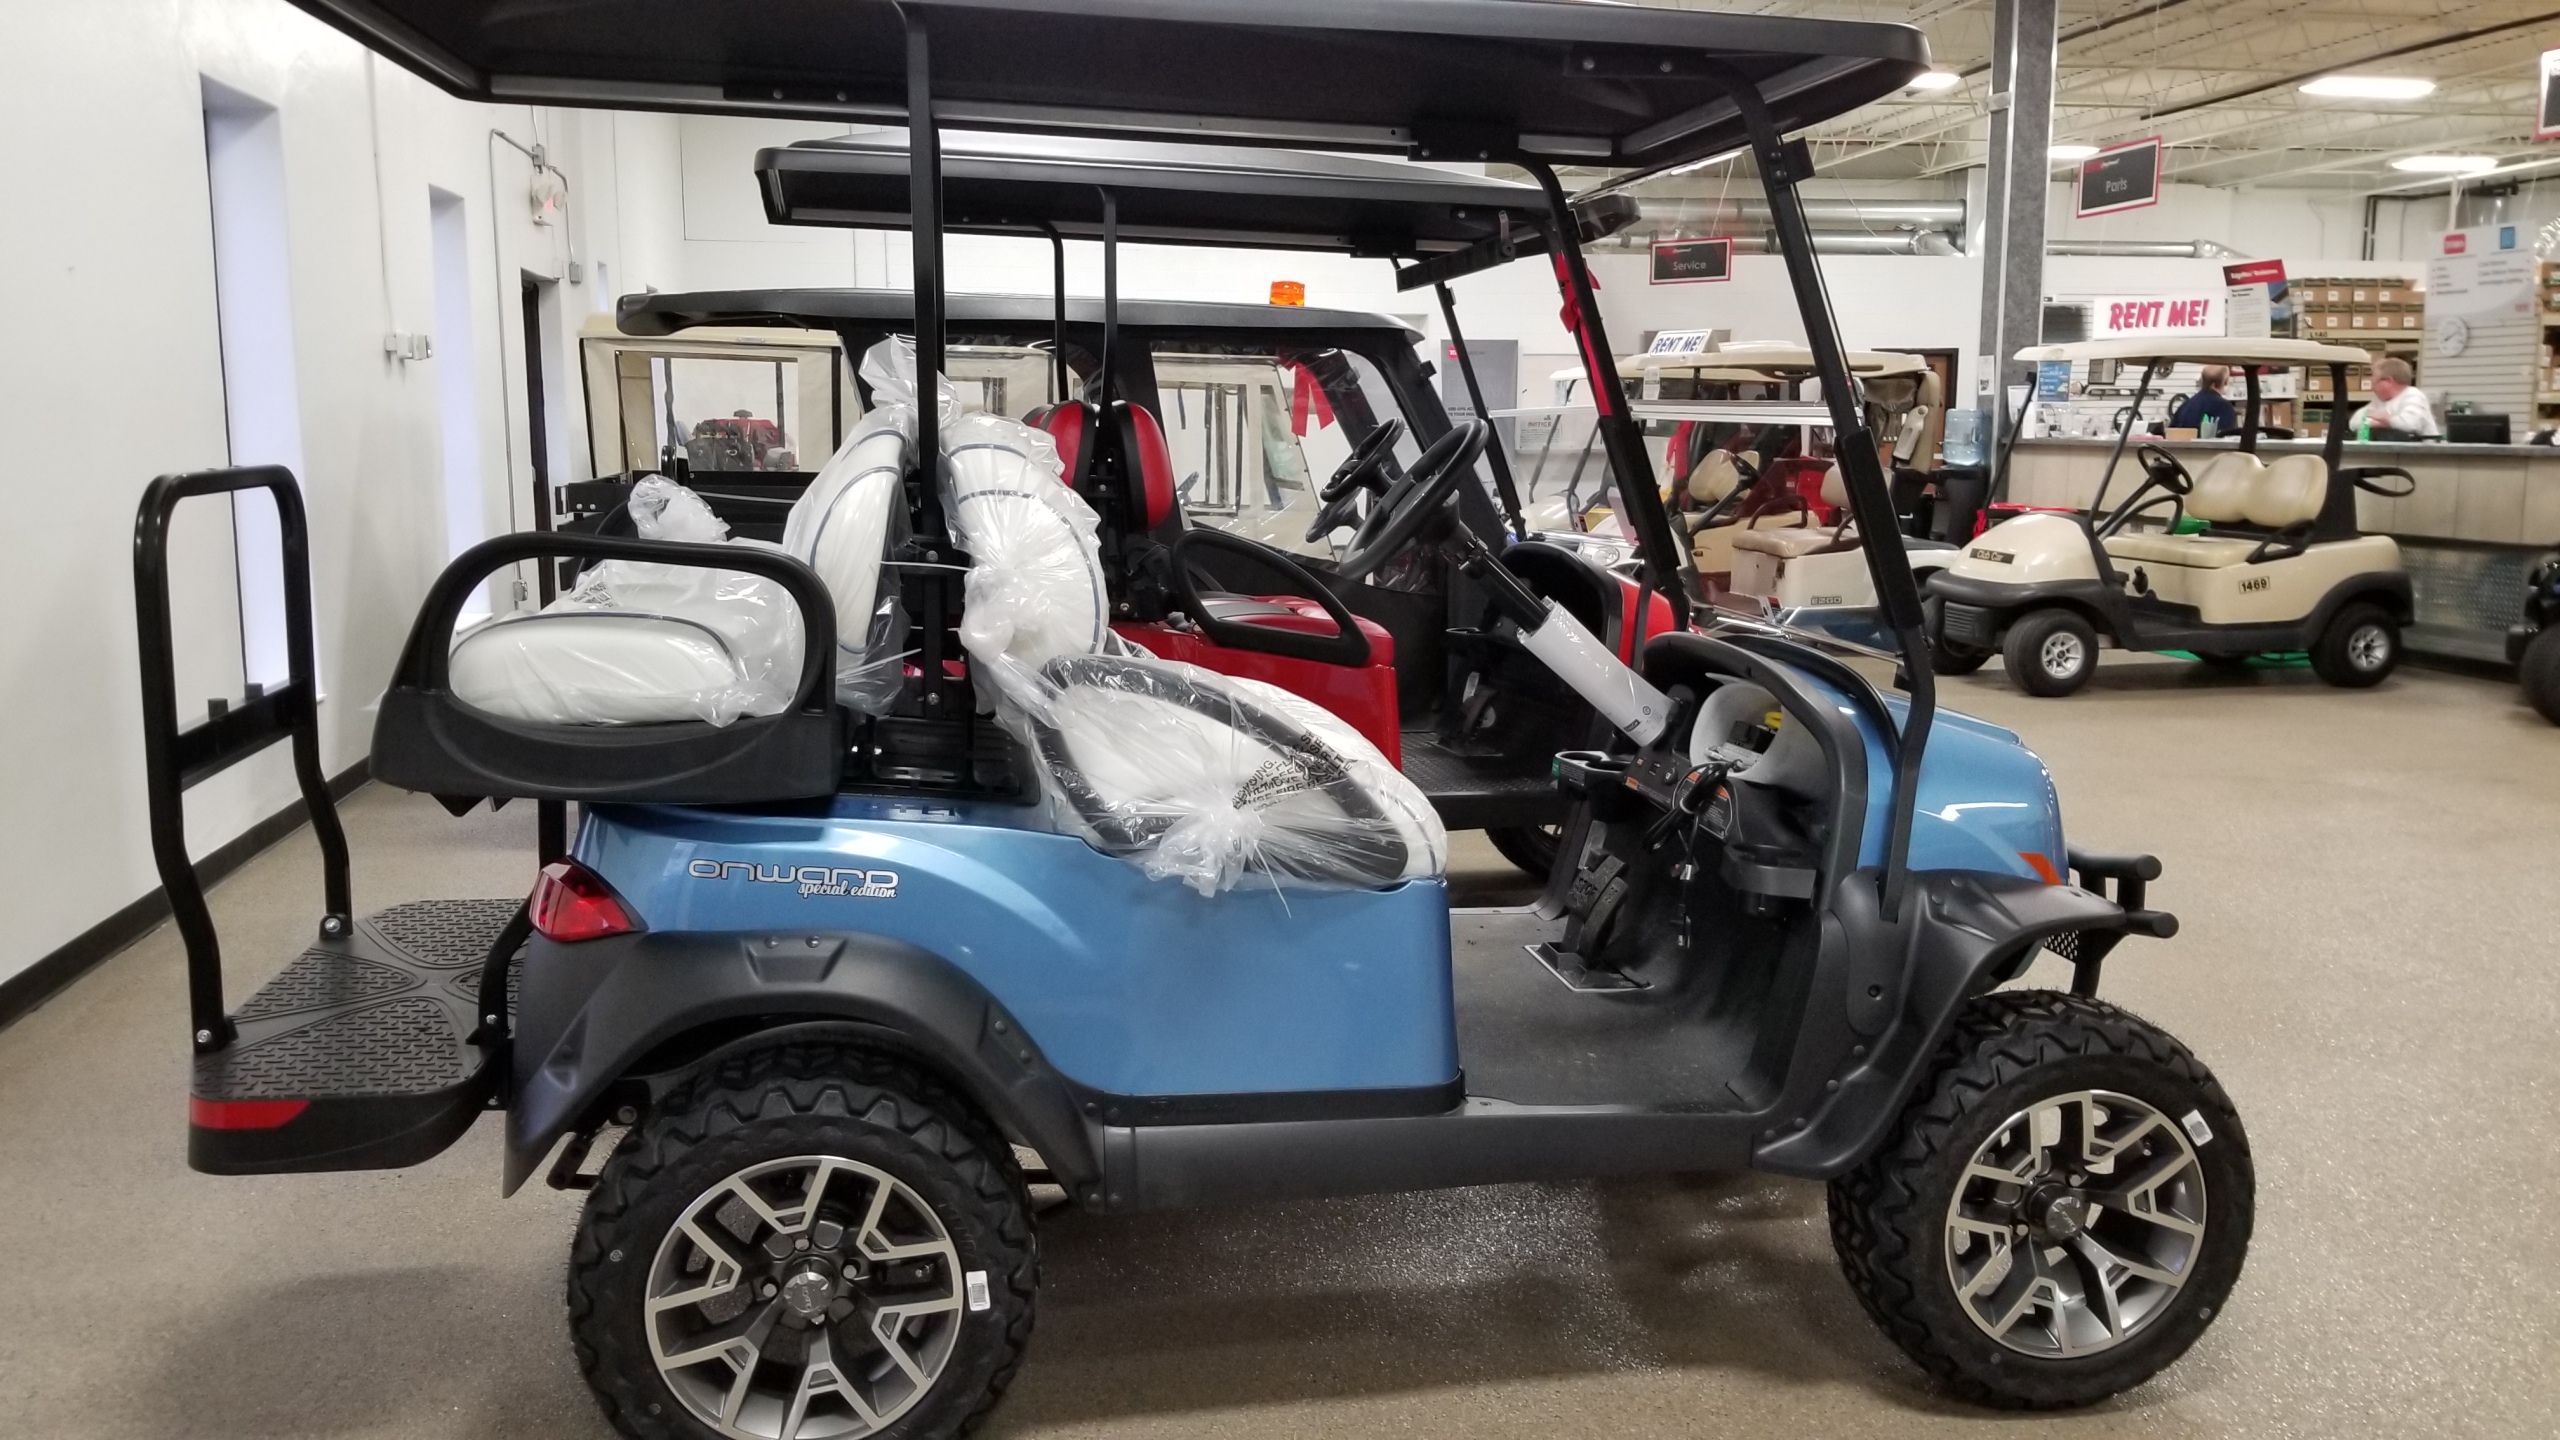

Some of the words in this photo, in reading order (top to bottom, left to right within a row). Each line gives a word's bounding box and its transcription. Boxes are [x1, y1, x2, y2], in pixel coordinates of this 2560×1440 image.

[2106, 178, 2128, 193] Parts
[1672, 260, 1707, 271] Service
[2109, 301, 2165, 332] RENT
[2167, 299, 2209, 327] ME!
[1652, 336, 1684, 354] RENT
[1680, 335, 1706, 352] ME!
[2241, 578, 2267, 592] 1469
[798, 880, 849, 898] special
[850, 884, 898, 899] edition
